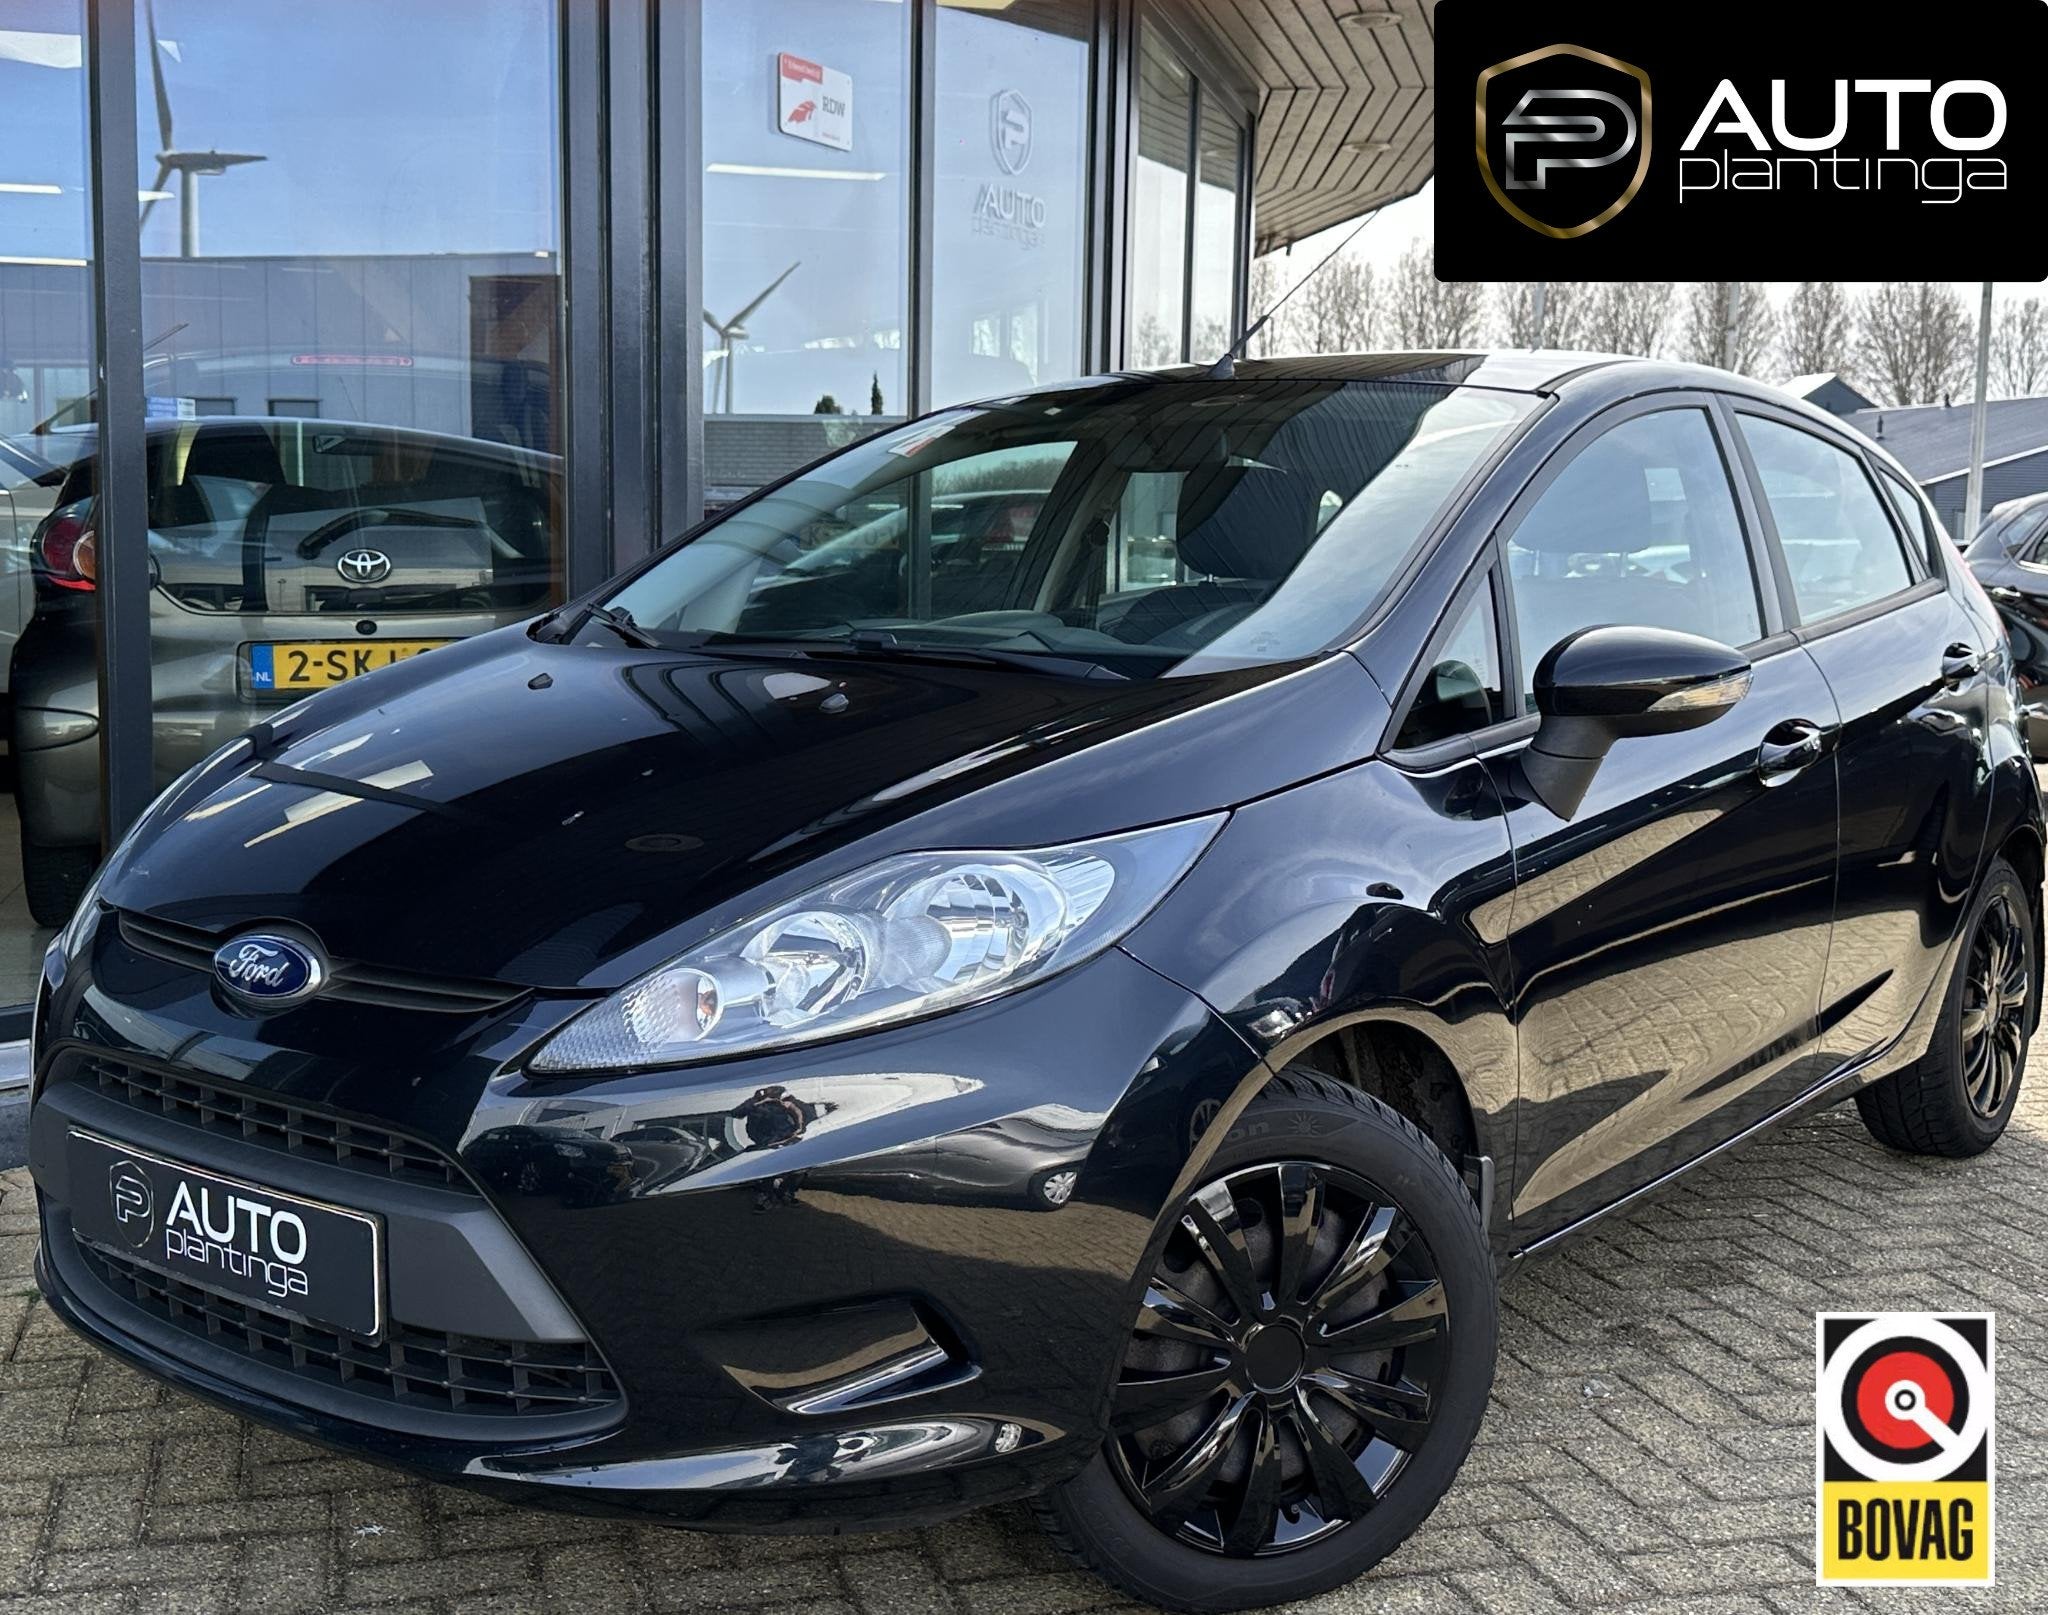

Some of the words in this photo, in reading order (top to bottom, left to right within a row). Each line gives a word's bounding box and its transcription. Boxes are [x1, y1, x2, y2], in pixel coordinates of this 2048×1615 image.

[821, 95, 846, 118] RDW
[980, 183, 1047, 229] AUTO
[256, 672, 272, 683] NL
[228, 943, 290, 988] Ford
[166, 1180, 308, 1265] AUTO
[166, 1227, 310, 1298] plantinga
